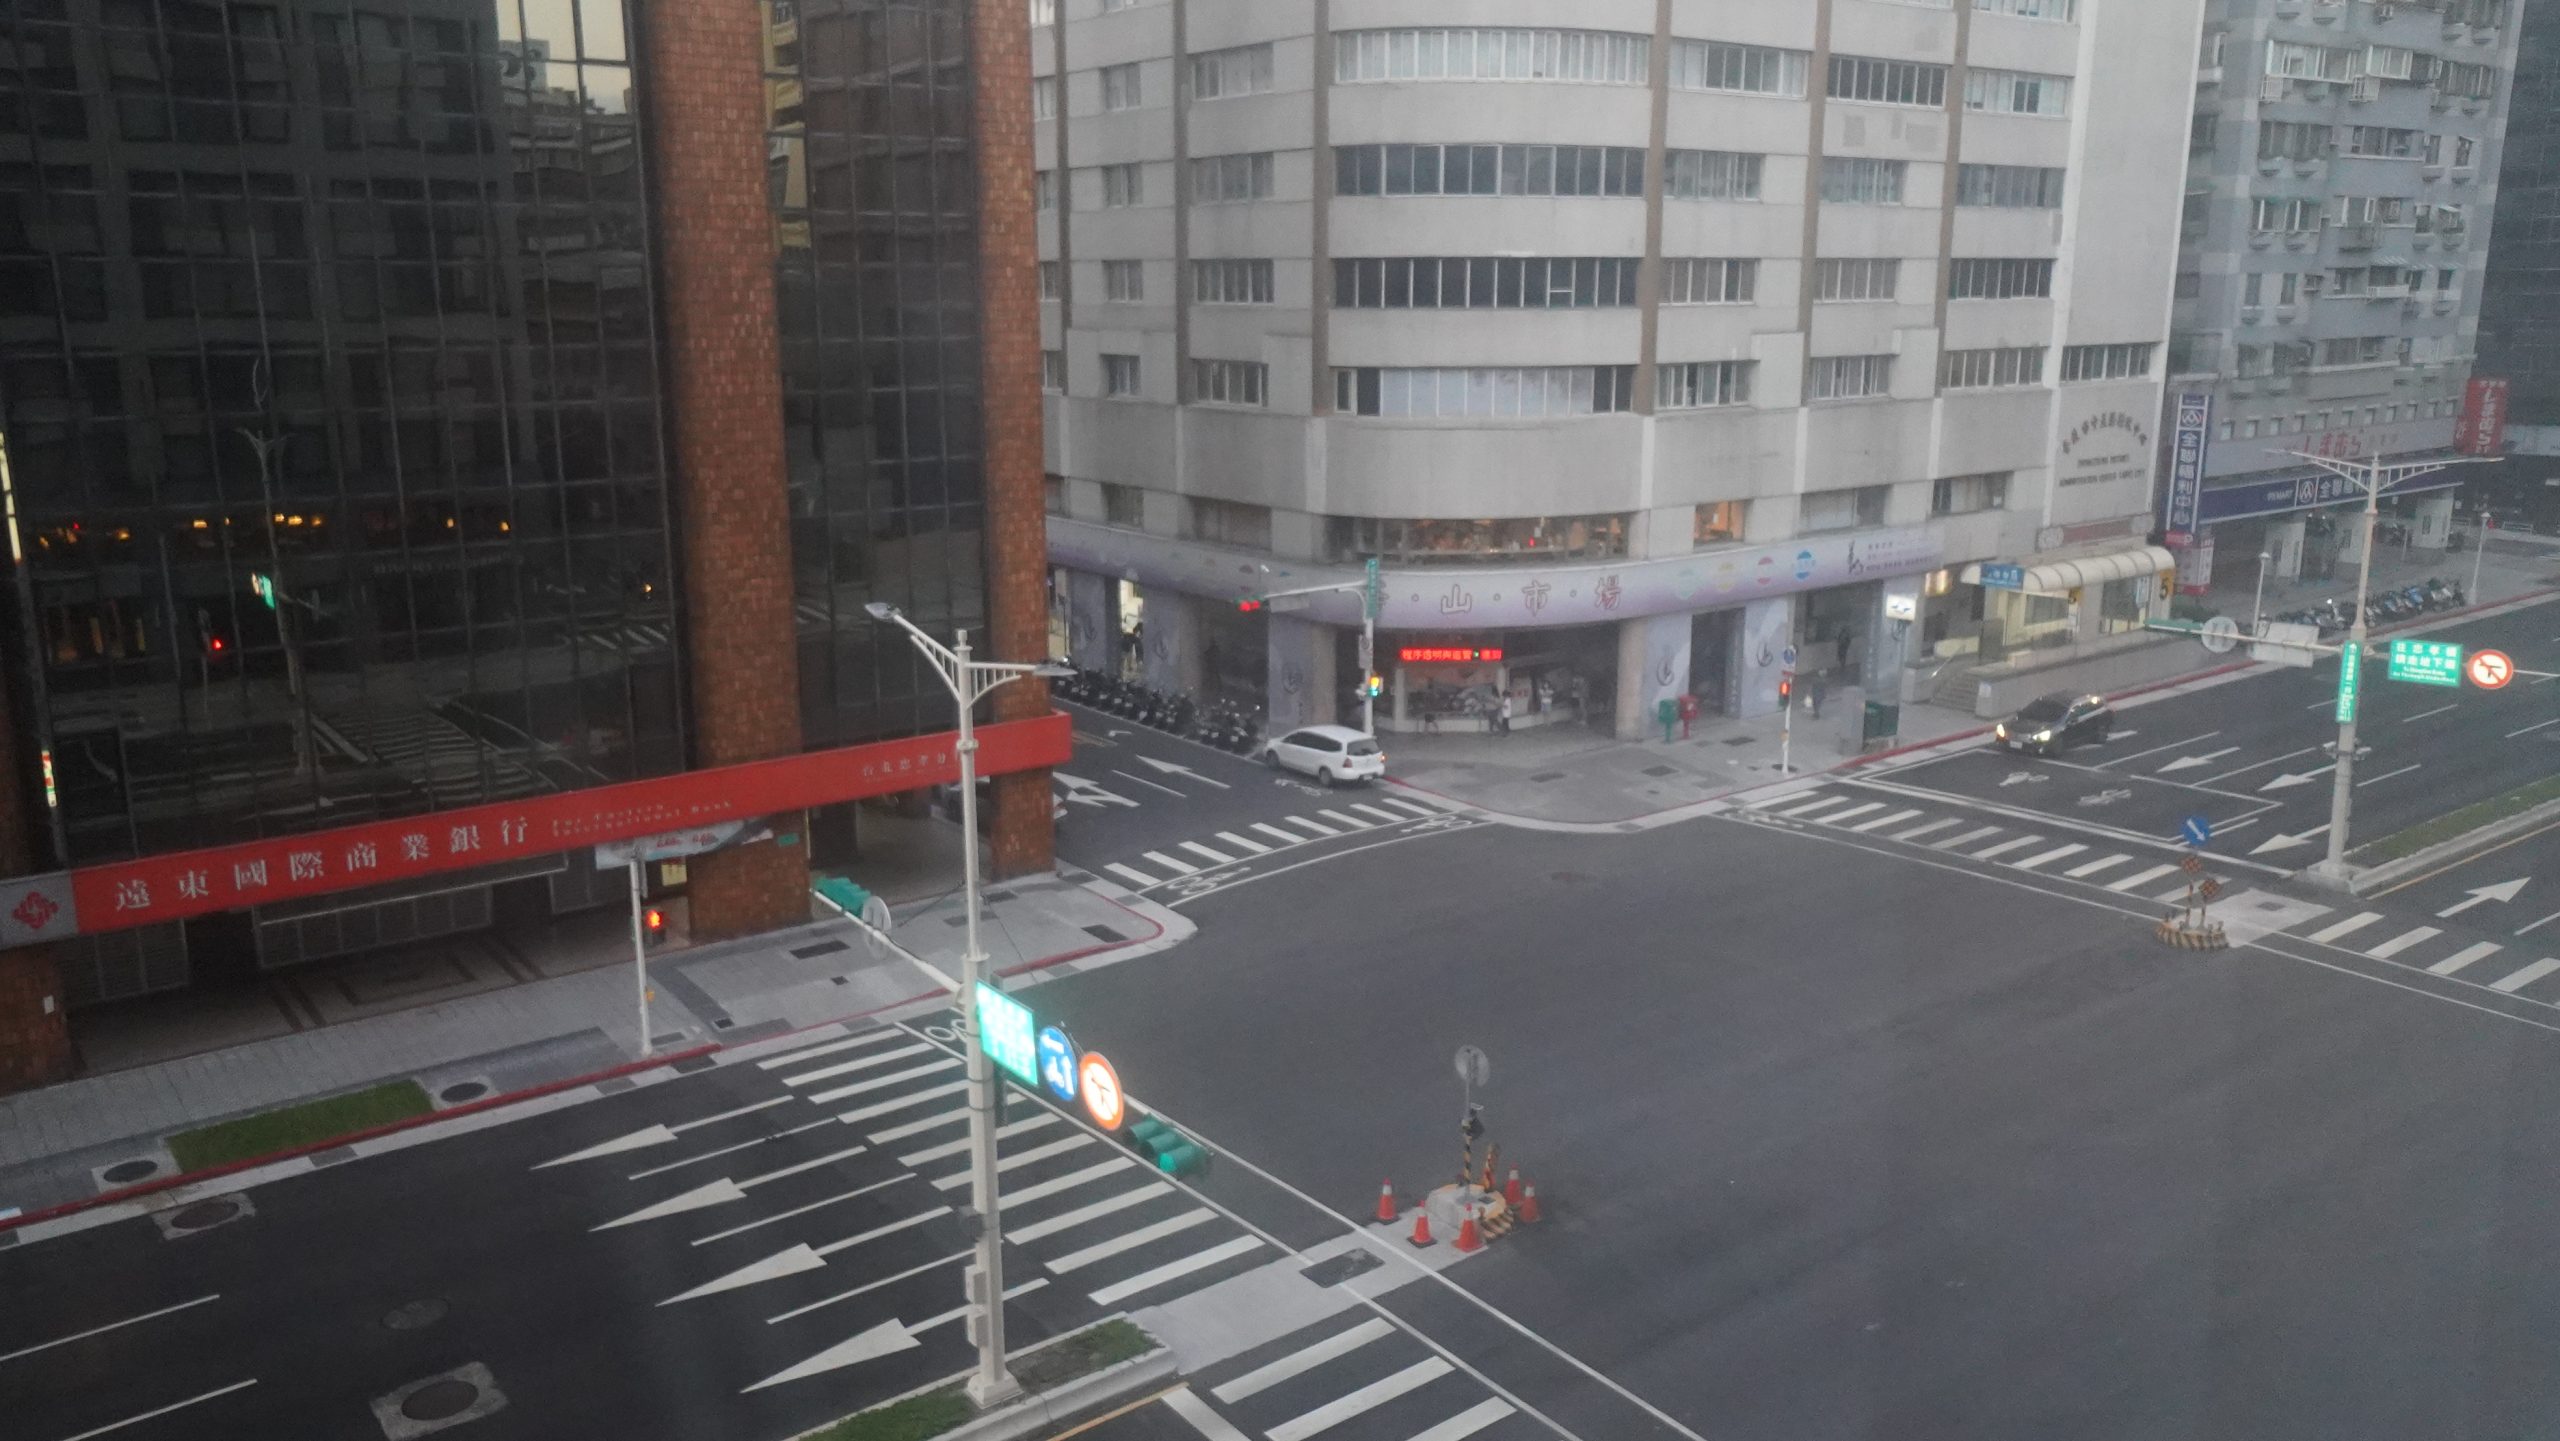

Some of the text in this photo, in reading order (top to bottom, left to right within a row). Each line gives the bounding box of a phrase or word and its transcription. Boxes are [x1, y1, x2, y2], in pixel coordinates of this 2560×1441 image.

[2173, 431, 2199, 525] 全聯福利中心
[2160, 577, 2170, 601] 5
[115, 816, 528, 911] 遠東國際商業銀行
